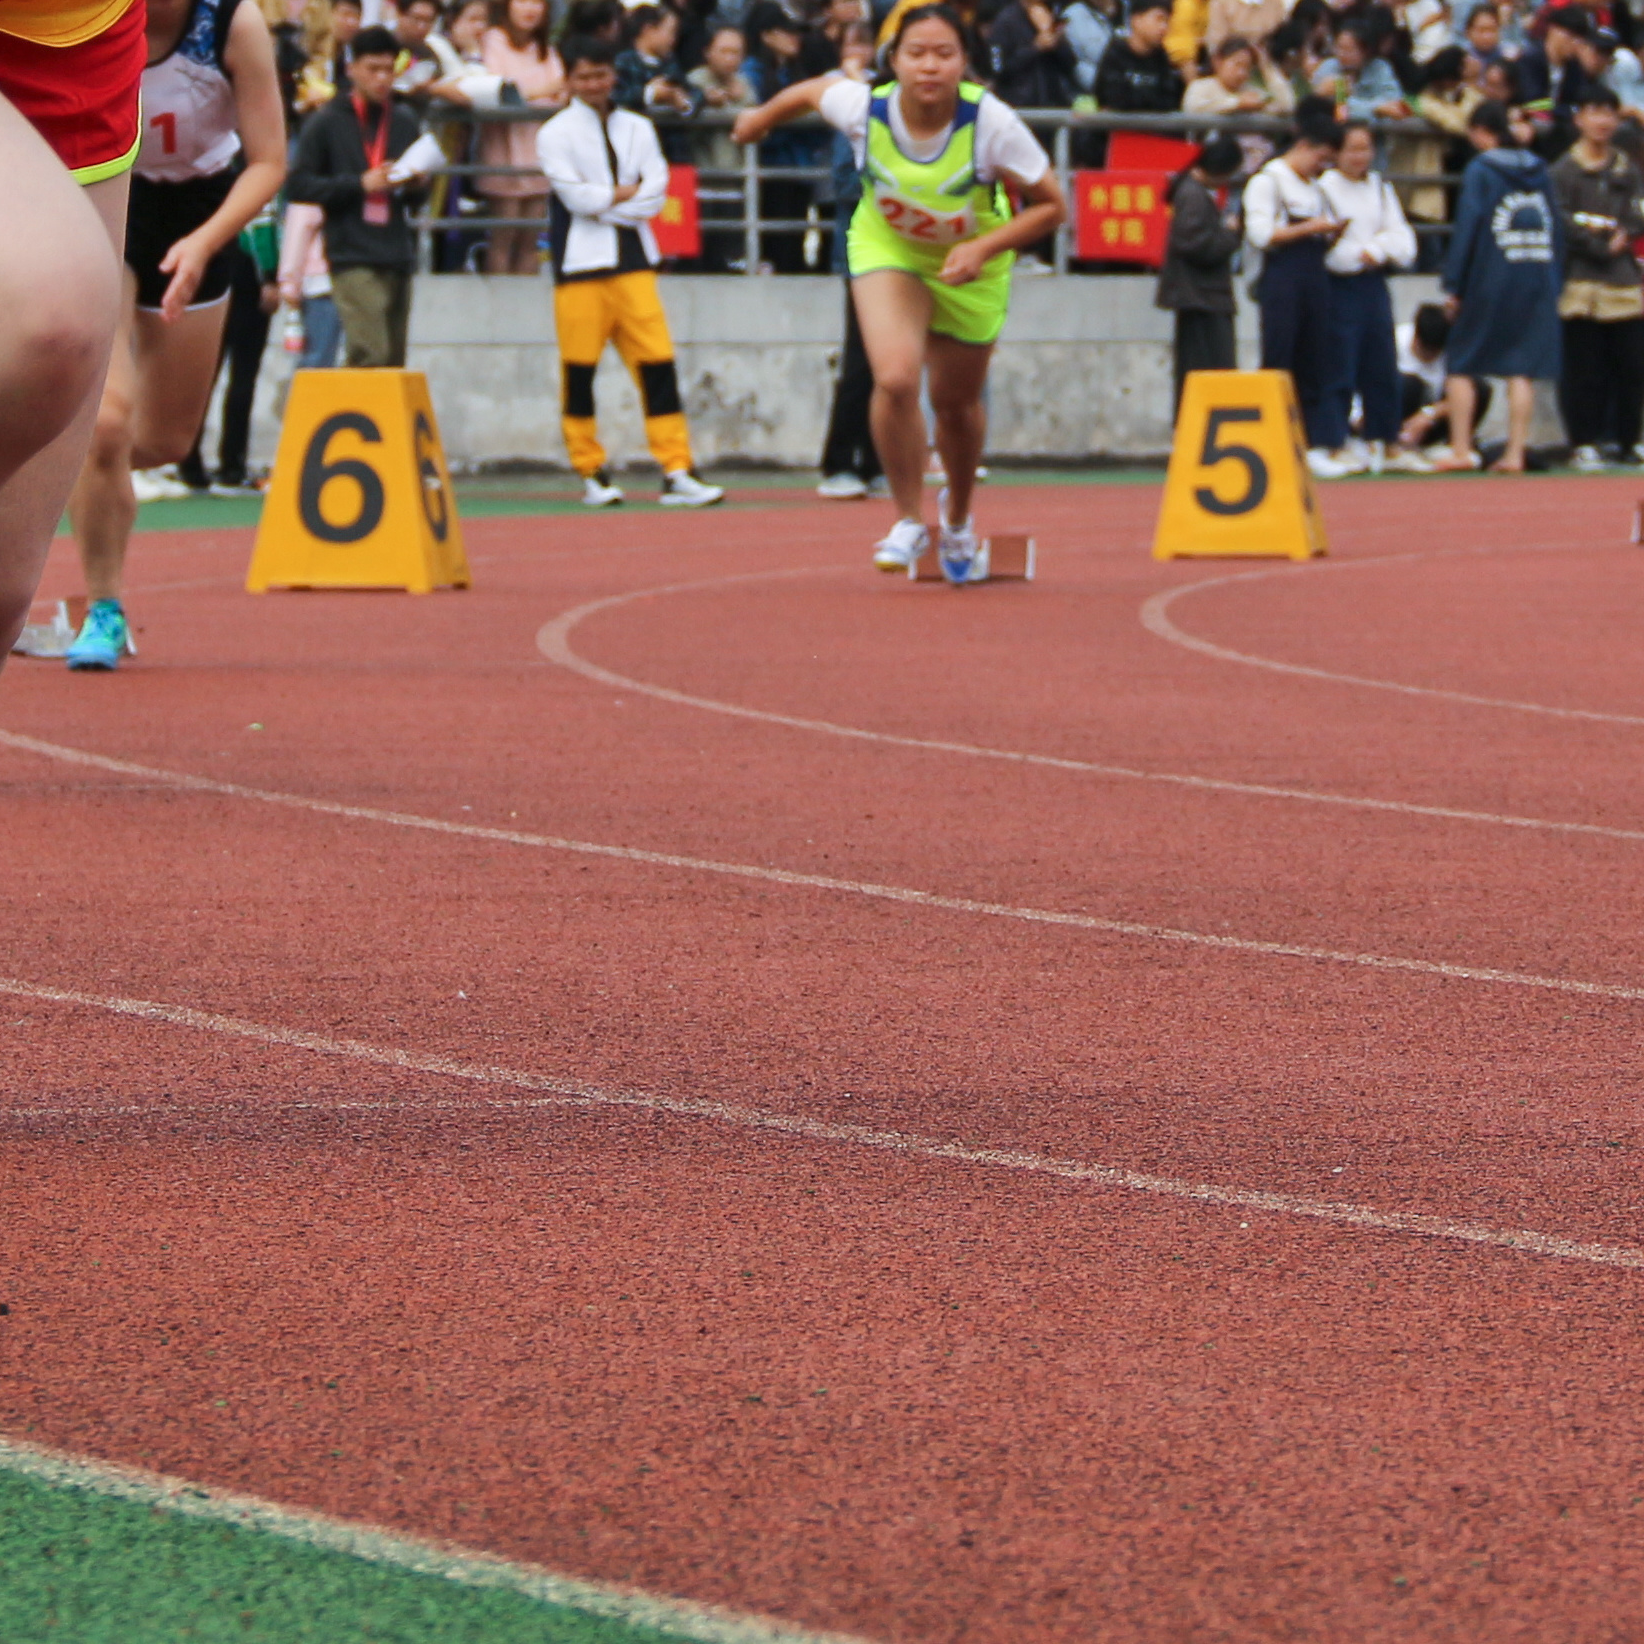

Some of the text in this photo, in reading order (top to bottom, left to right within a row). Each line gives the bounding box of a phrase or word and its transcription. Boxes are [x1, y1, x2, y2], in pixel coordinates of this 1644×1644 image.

[150, 111, 176, 154] 1
[298, 411, 385, 544] 6
[1194, 407, 1269, 517] 5
